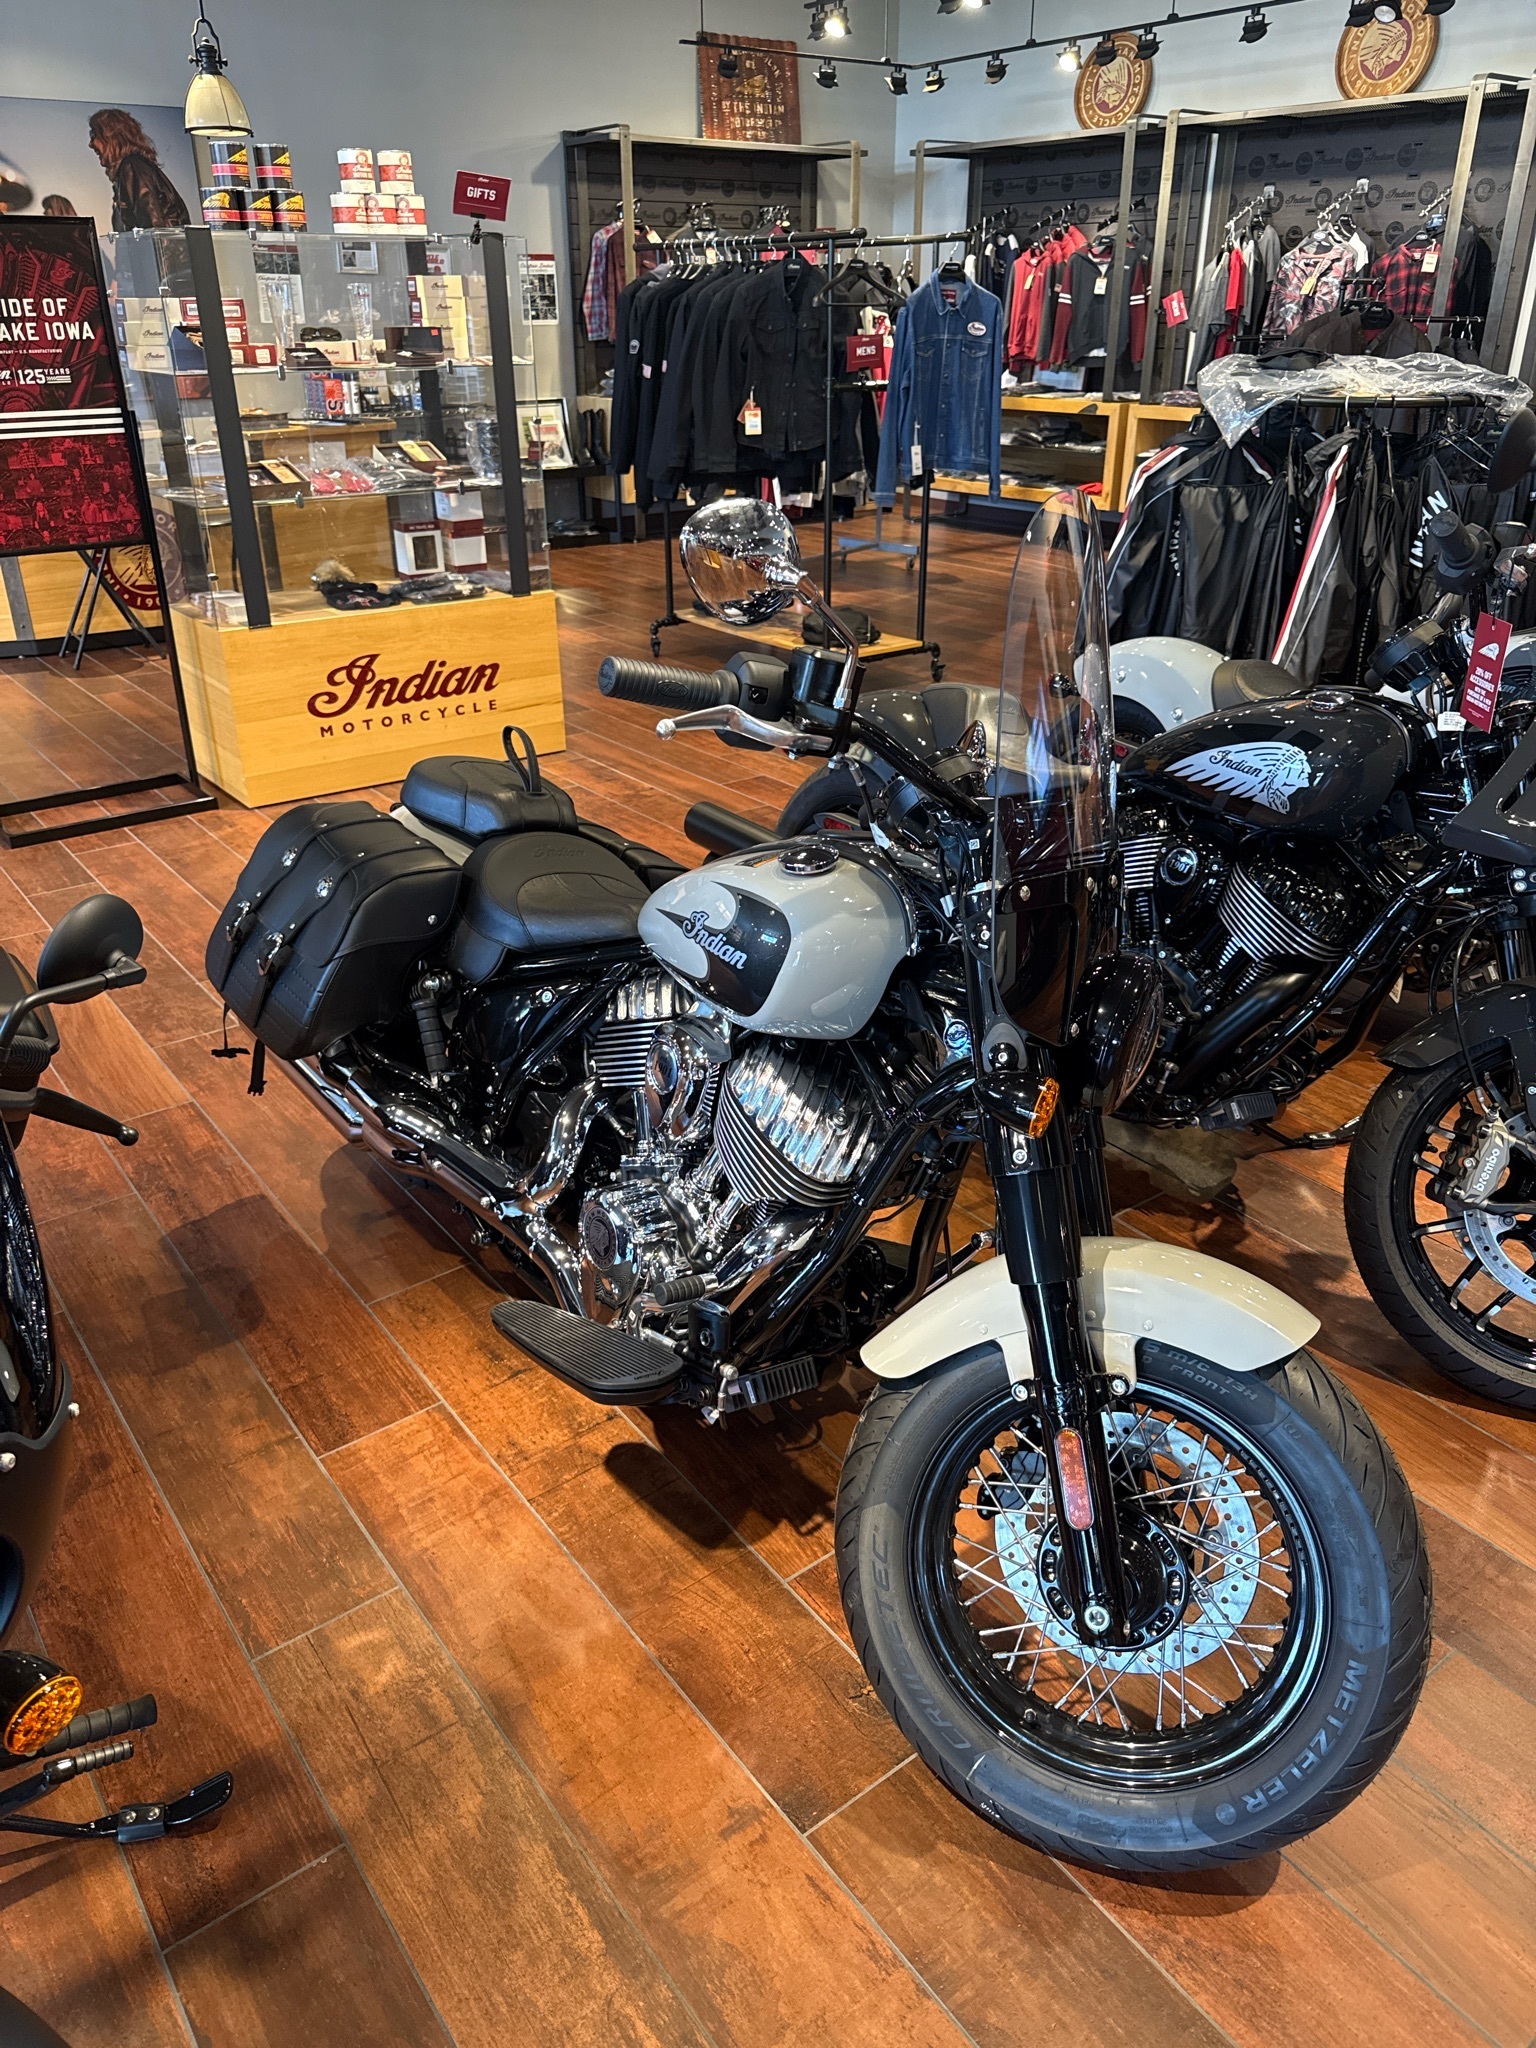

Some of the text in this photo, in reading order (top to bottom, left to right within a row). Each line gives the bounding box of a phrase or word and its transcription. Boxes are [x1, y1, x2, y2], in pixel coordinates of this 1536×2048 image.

[1093, 62, 1141, 126] MOTORCYCLE
[466, 186, 497, 201] GIFTS
[1285, 194, 1313, 204] Indian
[1385, 188, 1416, 199] Indian
[0, 298, 68, 317] IDE OF
[44, 321, 95, 340] IOWA
[856, 345, 877, 357] MENS
[17, 369, 46, 385] 125
[307, 653, 501, 719] Indian
[320, 699, 498, 738] MOTORCYCLE
[1208, 749, 1263, 778] Indian
[1168, 859, 1191, 874] 1901
[681, 911, 748, 970] Indian
[1473, 1148, 1500, 1192] brembo
[1169, 1364, 1231, 1396] FRONT
[871, 1530, 972, 1750] CRUISETEC
[1240, 1659, 1369, 1814] METZELER
